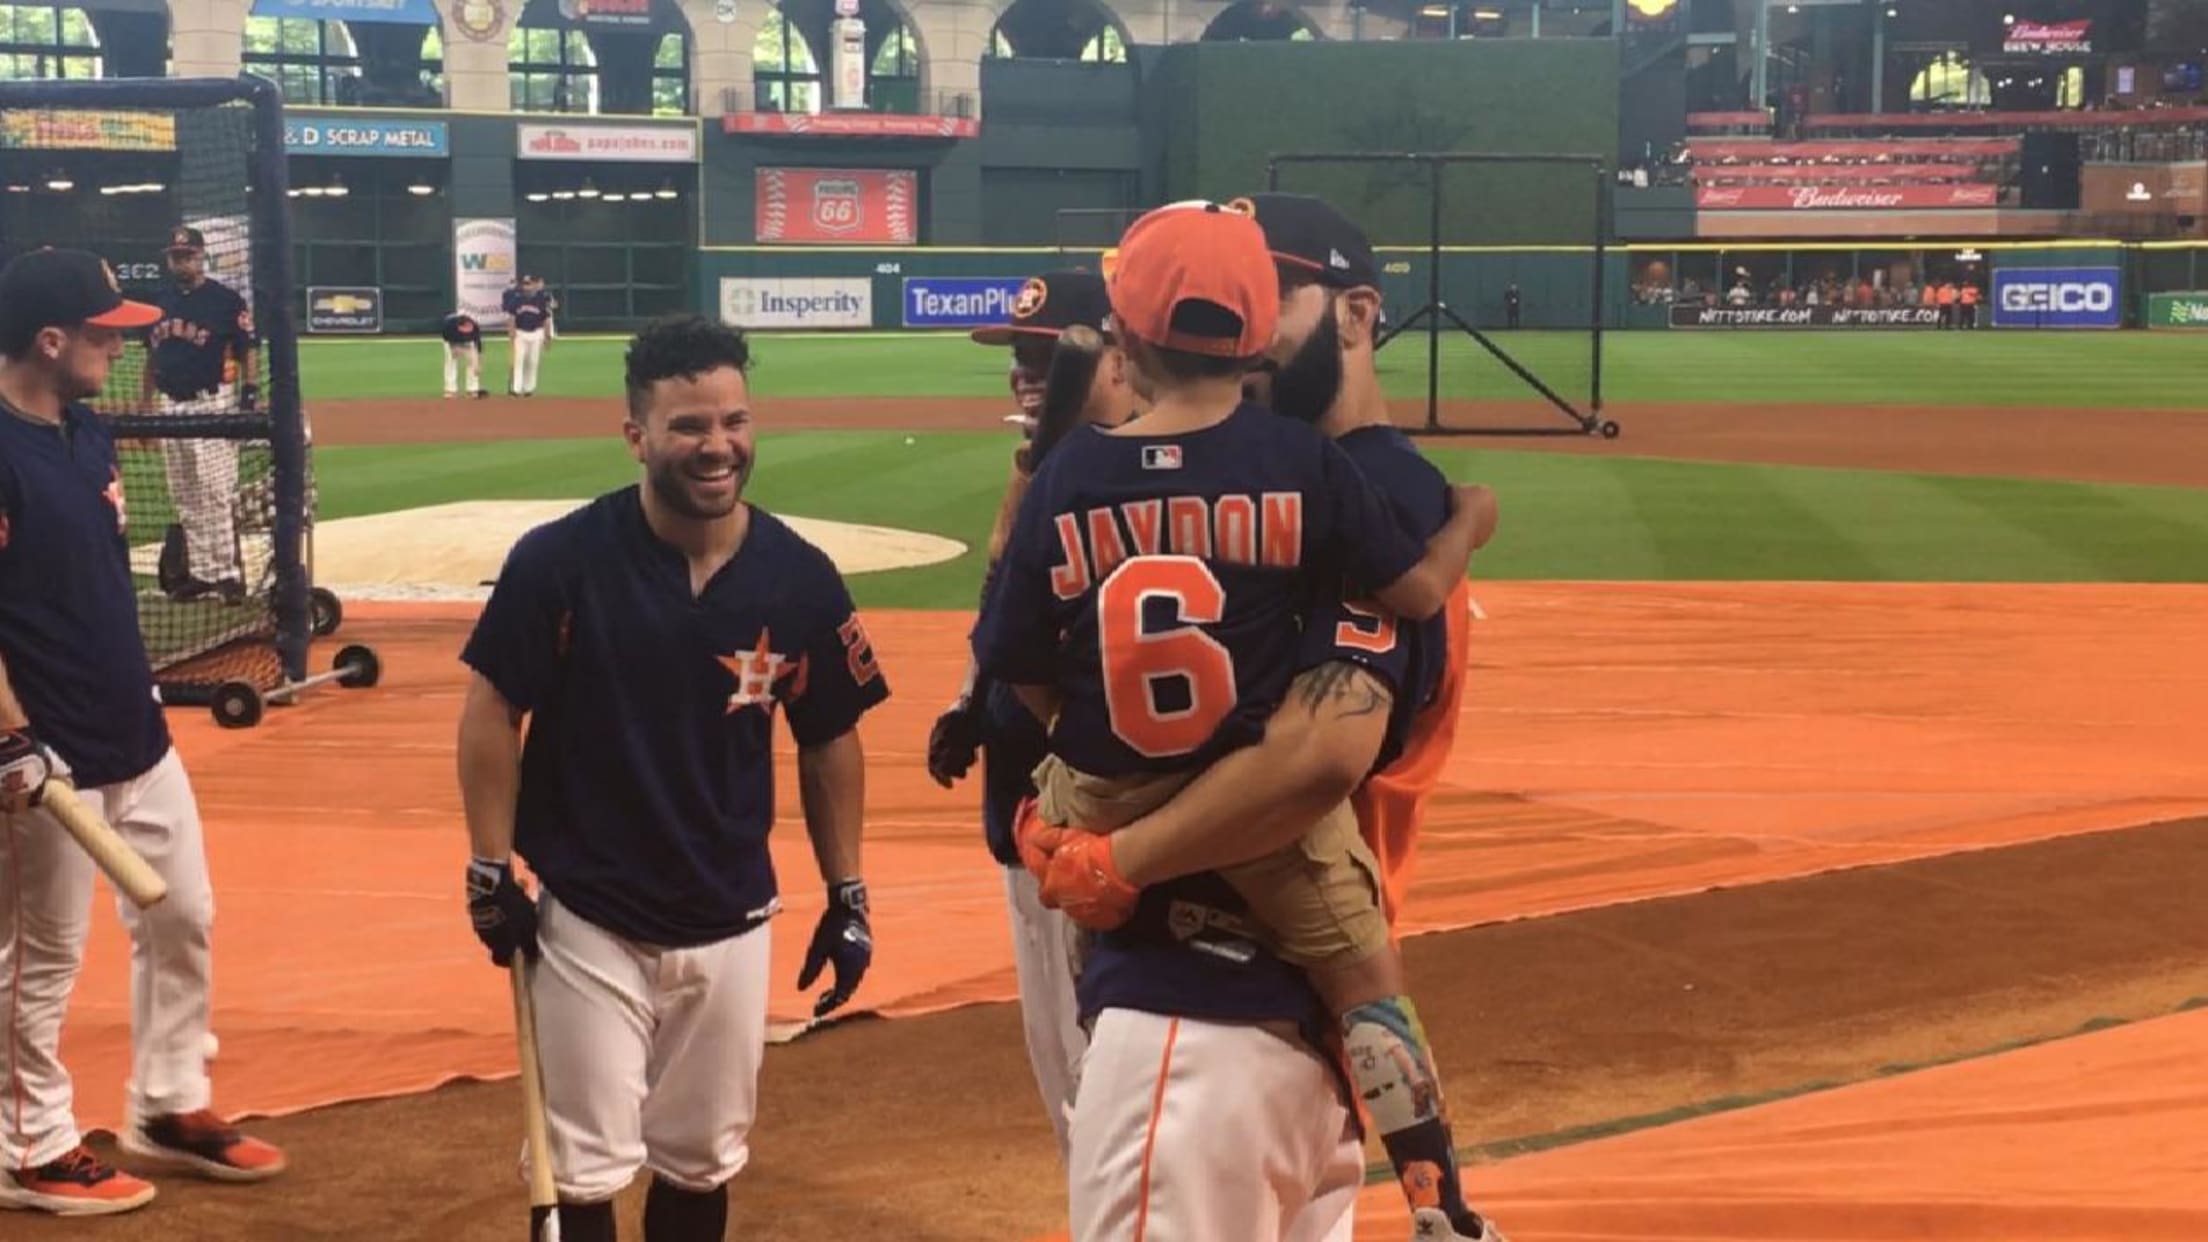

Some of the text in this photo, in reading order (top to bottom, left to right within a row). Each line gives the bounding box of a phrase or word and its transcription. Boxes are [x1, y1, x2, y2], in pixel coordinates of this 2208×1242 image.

[303, 127, 320, 145] D
[326, 128, 379, 146] SCRAP
[384, 130, 436, 147] METAL
[1788, 186, 1902, 207] Budweiser
[821, 200, 851, 222] 66
[117, 263, 161, 279] 362
[761, 291, 862, 317] Insperity
[912, 287, 1016, 316] TexanPlu
[2002, 282, 2113, 312] GEICO
[1051, 491, 1302, 600] JAYDON
[1098, 554, 1237, 757] 6
[728, 649, 787, 705] H
